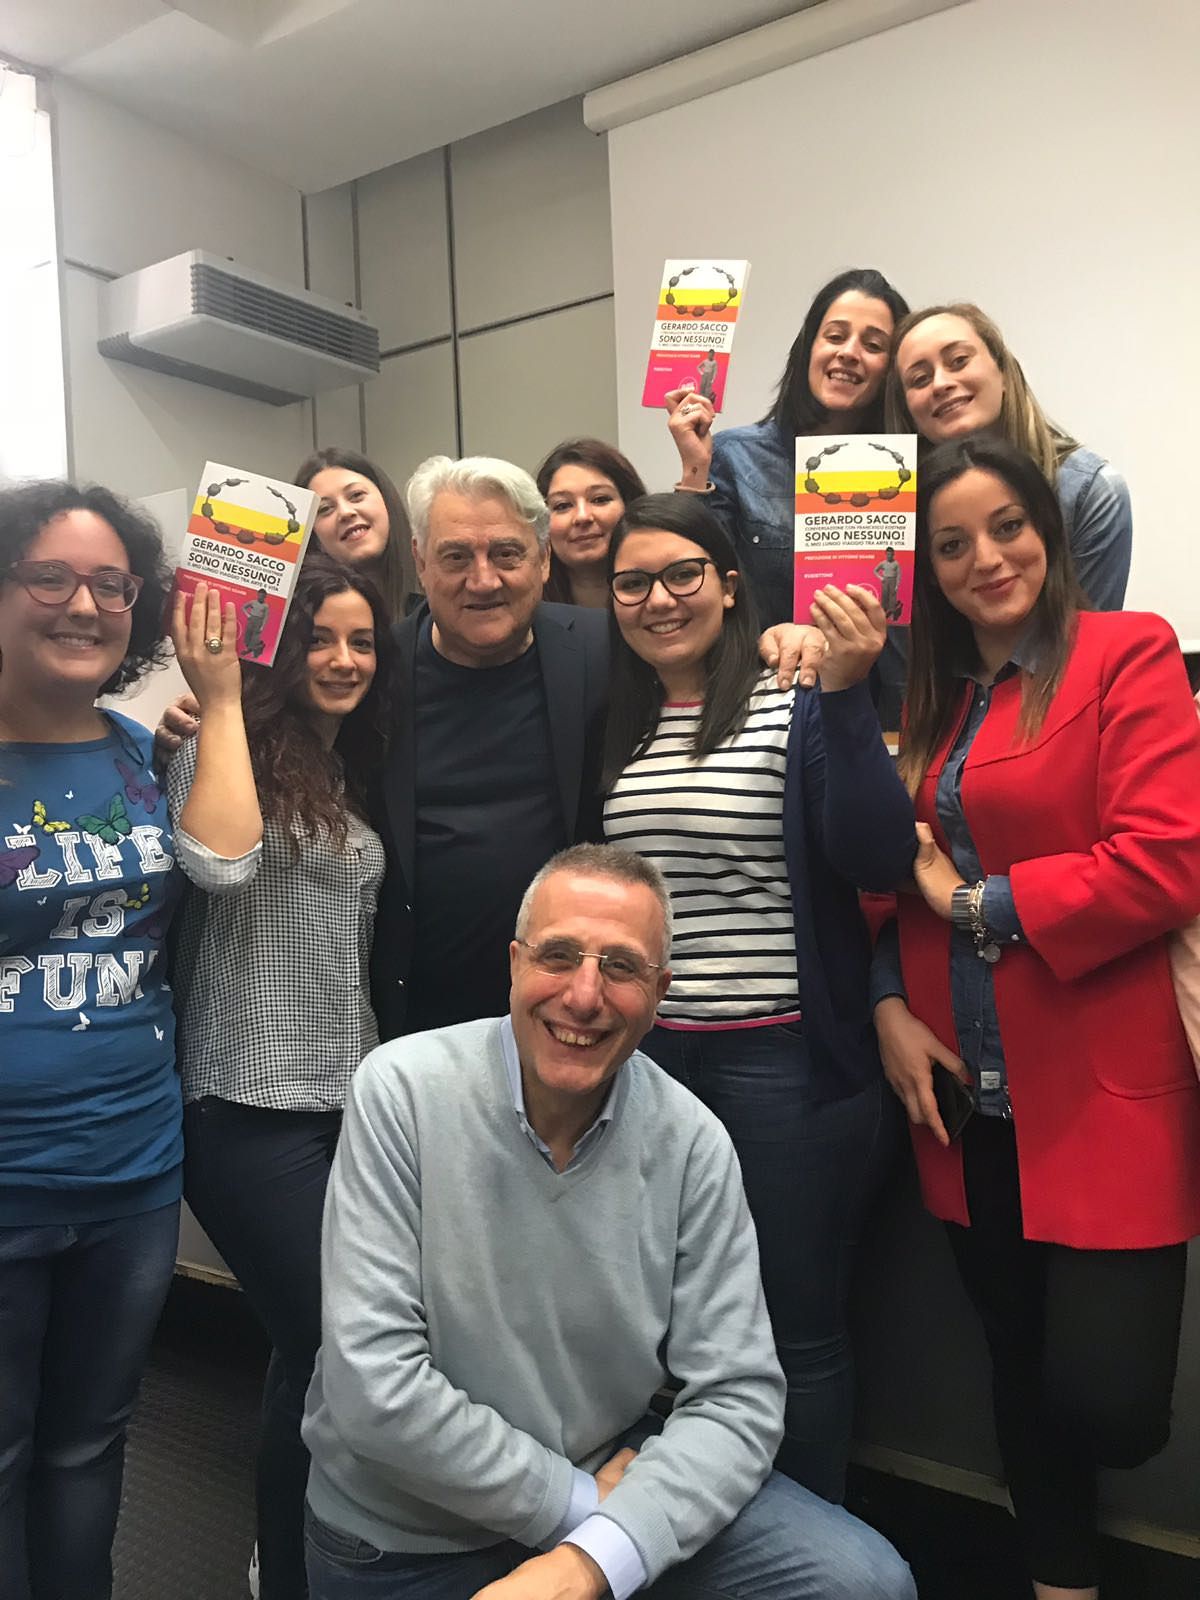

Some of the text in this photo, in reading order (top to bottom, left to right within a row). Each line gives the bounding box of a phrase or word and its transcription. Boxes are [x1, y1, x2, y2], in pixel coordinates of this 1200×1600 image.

[660, 322, 728, 332] GERARDO SACCO
[684, 336, 725, 344] NESSUNO!
[805, 515, 906, 526] GERARDO SACCO
[805, 531, 904, 542] SONO NESSUNO!
[192, 538, 286, 572] GERARDO SACCO
[189, 552, 220, 568] SONO
[222, 562, 281, 586] NESSUNO!
[5, 825, 174, 891] LIFE
[50, 888, 128, 939] IS
